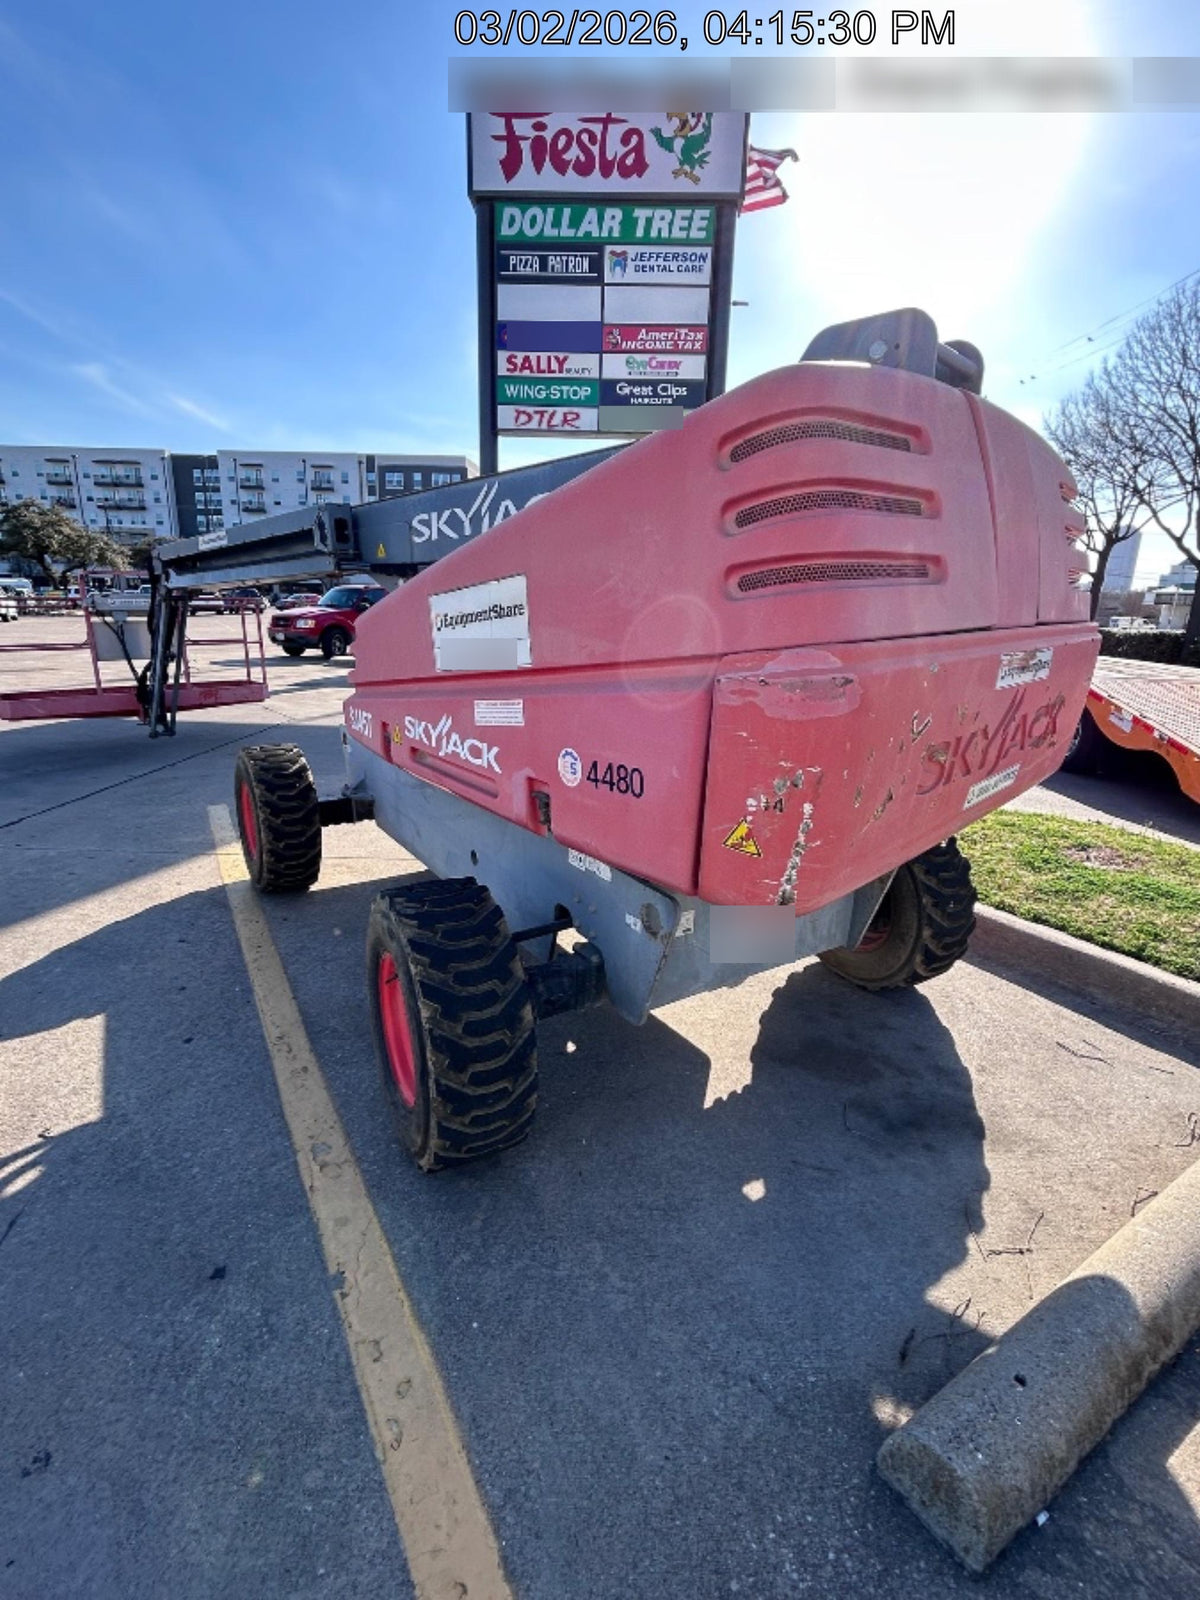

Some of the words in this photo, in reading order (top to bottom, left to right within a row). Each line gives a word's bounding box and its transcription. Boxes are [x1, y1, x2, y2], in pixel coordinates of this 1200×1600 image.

[490, 112, 649, 183] Fiesta
[500, 207, 622, 238] DOLLAR
[632, 209, 711, 239] TREE
[509, 255, 540, 273] PIZZA
[630, 251, 709, 263] JEFFERSON
[634, 264, 675, 273] DENTAL
[676, 264, 705, 274] CARE
[621, 340, 674, 350] INCOME
[676, 341, 703, 350] TAX
[637, 328, 704, 341] AmeriTax
[506, 353, 569, 375] SALLY
[616, 382, 653, 396] Great
[657, 383, 688, 399] Clips
[514, 408, 581, 429] DTLR
[411, 480, 552, 543] SKYJA
[404, 713, 502, 774] SKYJACK
[586, 760, 645, 799] 4480
